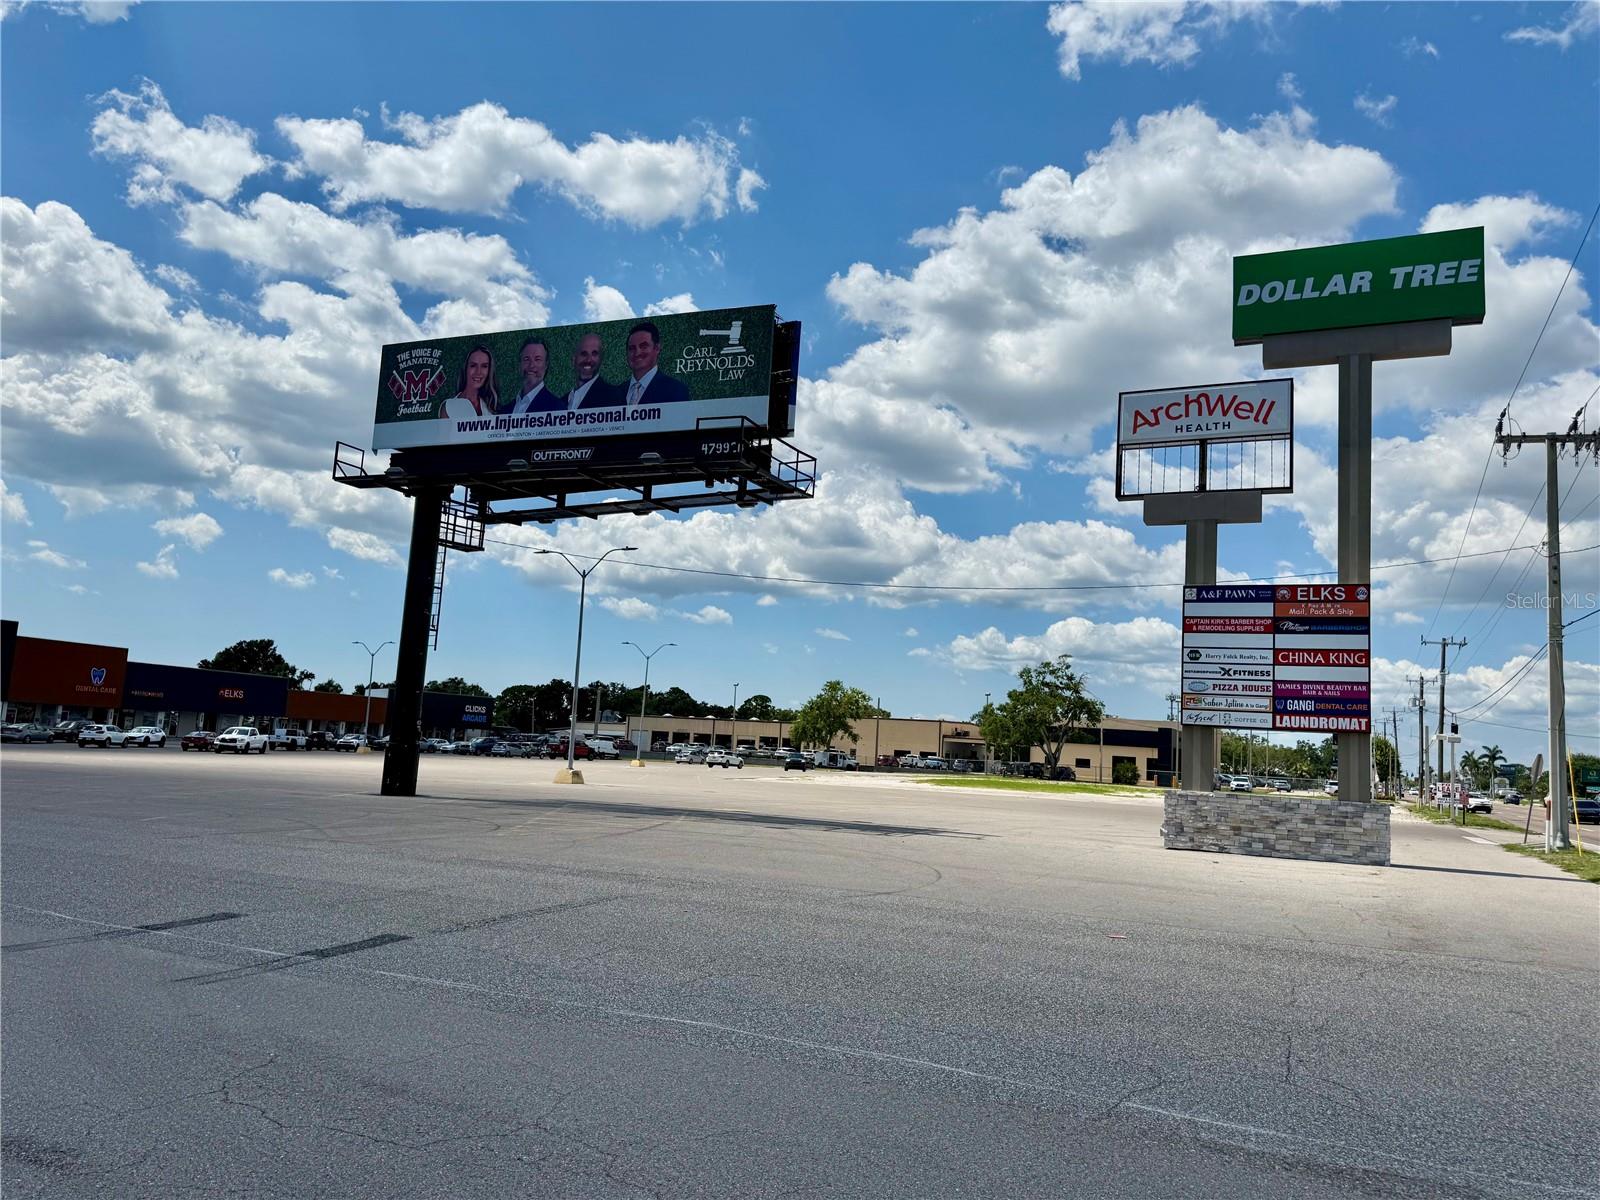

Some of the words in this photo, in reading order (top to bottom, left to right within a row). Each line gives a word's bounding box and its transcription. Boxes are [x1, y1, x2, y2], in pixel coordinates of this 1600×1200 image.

[1237, 270, 1372, 306] DOLLAR
[1390, 258, 1482, 290] TREE
[396, 350, 410, 362] THE
[412, 348, 432, 358] VOICE
[432, 348, 442, 358] OF
[682, 346, 716, 358] CARL
[398, 357, 440, 370] MANATEE
[674, 354, 754, 374] REYNOLDS
[719, 369, 746, 380] LAW
[402, 368, 430, 402] M
[396, 402, 432, 416] Football
[457, 407, 661, 432] www.InjuriesArePersonal.com
[1175, 421, 1230, 434] HEALTH
[1200, 590, 1223, 598] A&F
[1225, 590, 1256, 598] PAWN
[1297, 587, 1346, 600] ELKS
[1278, 652, 1325, 664] CHINA
[1329, 653, 1366, 664] KING
[224, 689, 244, 698] ELKS
[465, 705, 486, 714] CLICKS
[1287, 700, 1314, 711] GANGI
[1275, 715, 1368, 730] LAUNDROMAT
